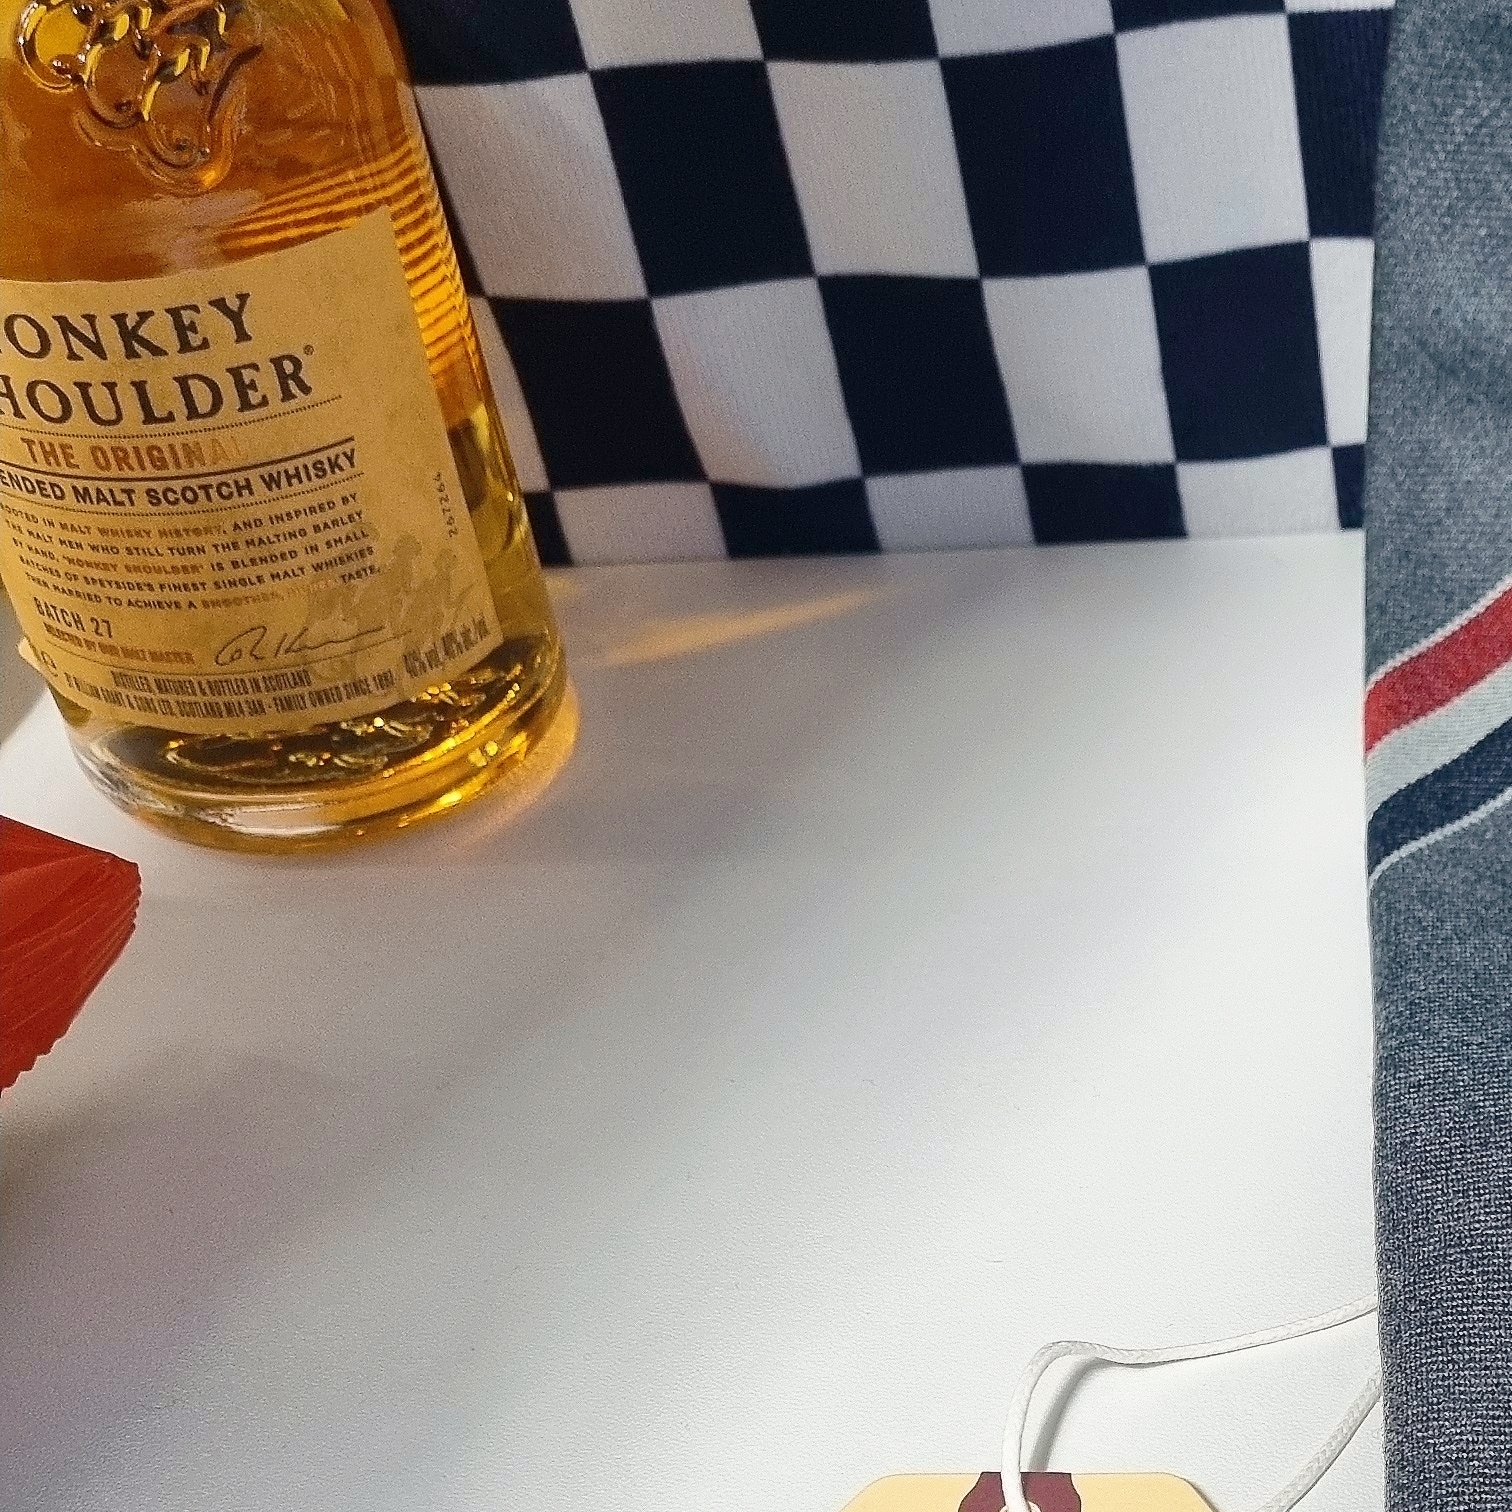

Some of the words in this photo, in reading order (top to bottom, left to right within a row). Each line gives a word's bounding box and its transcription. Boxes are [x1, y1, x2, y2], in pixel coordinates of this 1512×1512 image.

[0, 292, 252, 362] ONKEY
[21, 436, 81, 470] THE
[72, 484, 136, 507] MALT
[145, 476, 255, 507] SCOTCH
[261, 448, 357, 493] WHISKY
[88, 542, 120, 555] WHO
[126, 546, 165, 558] STILL
[168, 544, 206, 557] TURN
[212, 541, 241, 554] THE
[245, 527, 308, 550] MALTING
[312, 510, 363, 535] BARLEY
[233, 517, 264, 533] AND
[269, 500, 336, 526] INSPIRED
[341, 492, 357, 506] BY
[159, 581, 207, 593] FINEST
[213, 574, 266, 591] SINGLE
[270, 566, 307, 582] MALT
[312, 545, 376, 573] WHISKIES
[210, 561, 225, 572] IS
[231, 549, 299, 570] BLENDED
[304, 543, 320, 556] IN
[325, 528, 370, 550] SMALL
[34, 595, 87, 633] BATCH
[90, 616, 114, 638] 27
[105, 596, 123, 607] TO
[127, 598, 182, 610] ACHIEVE
[187, 600, 198, 610] A
